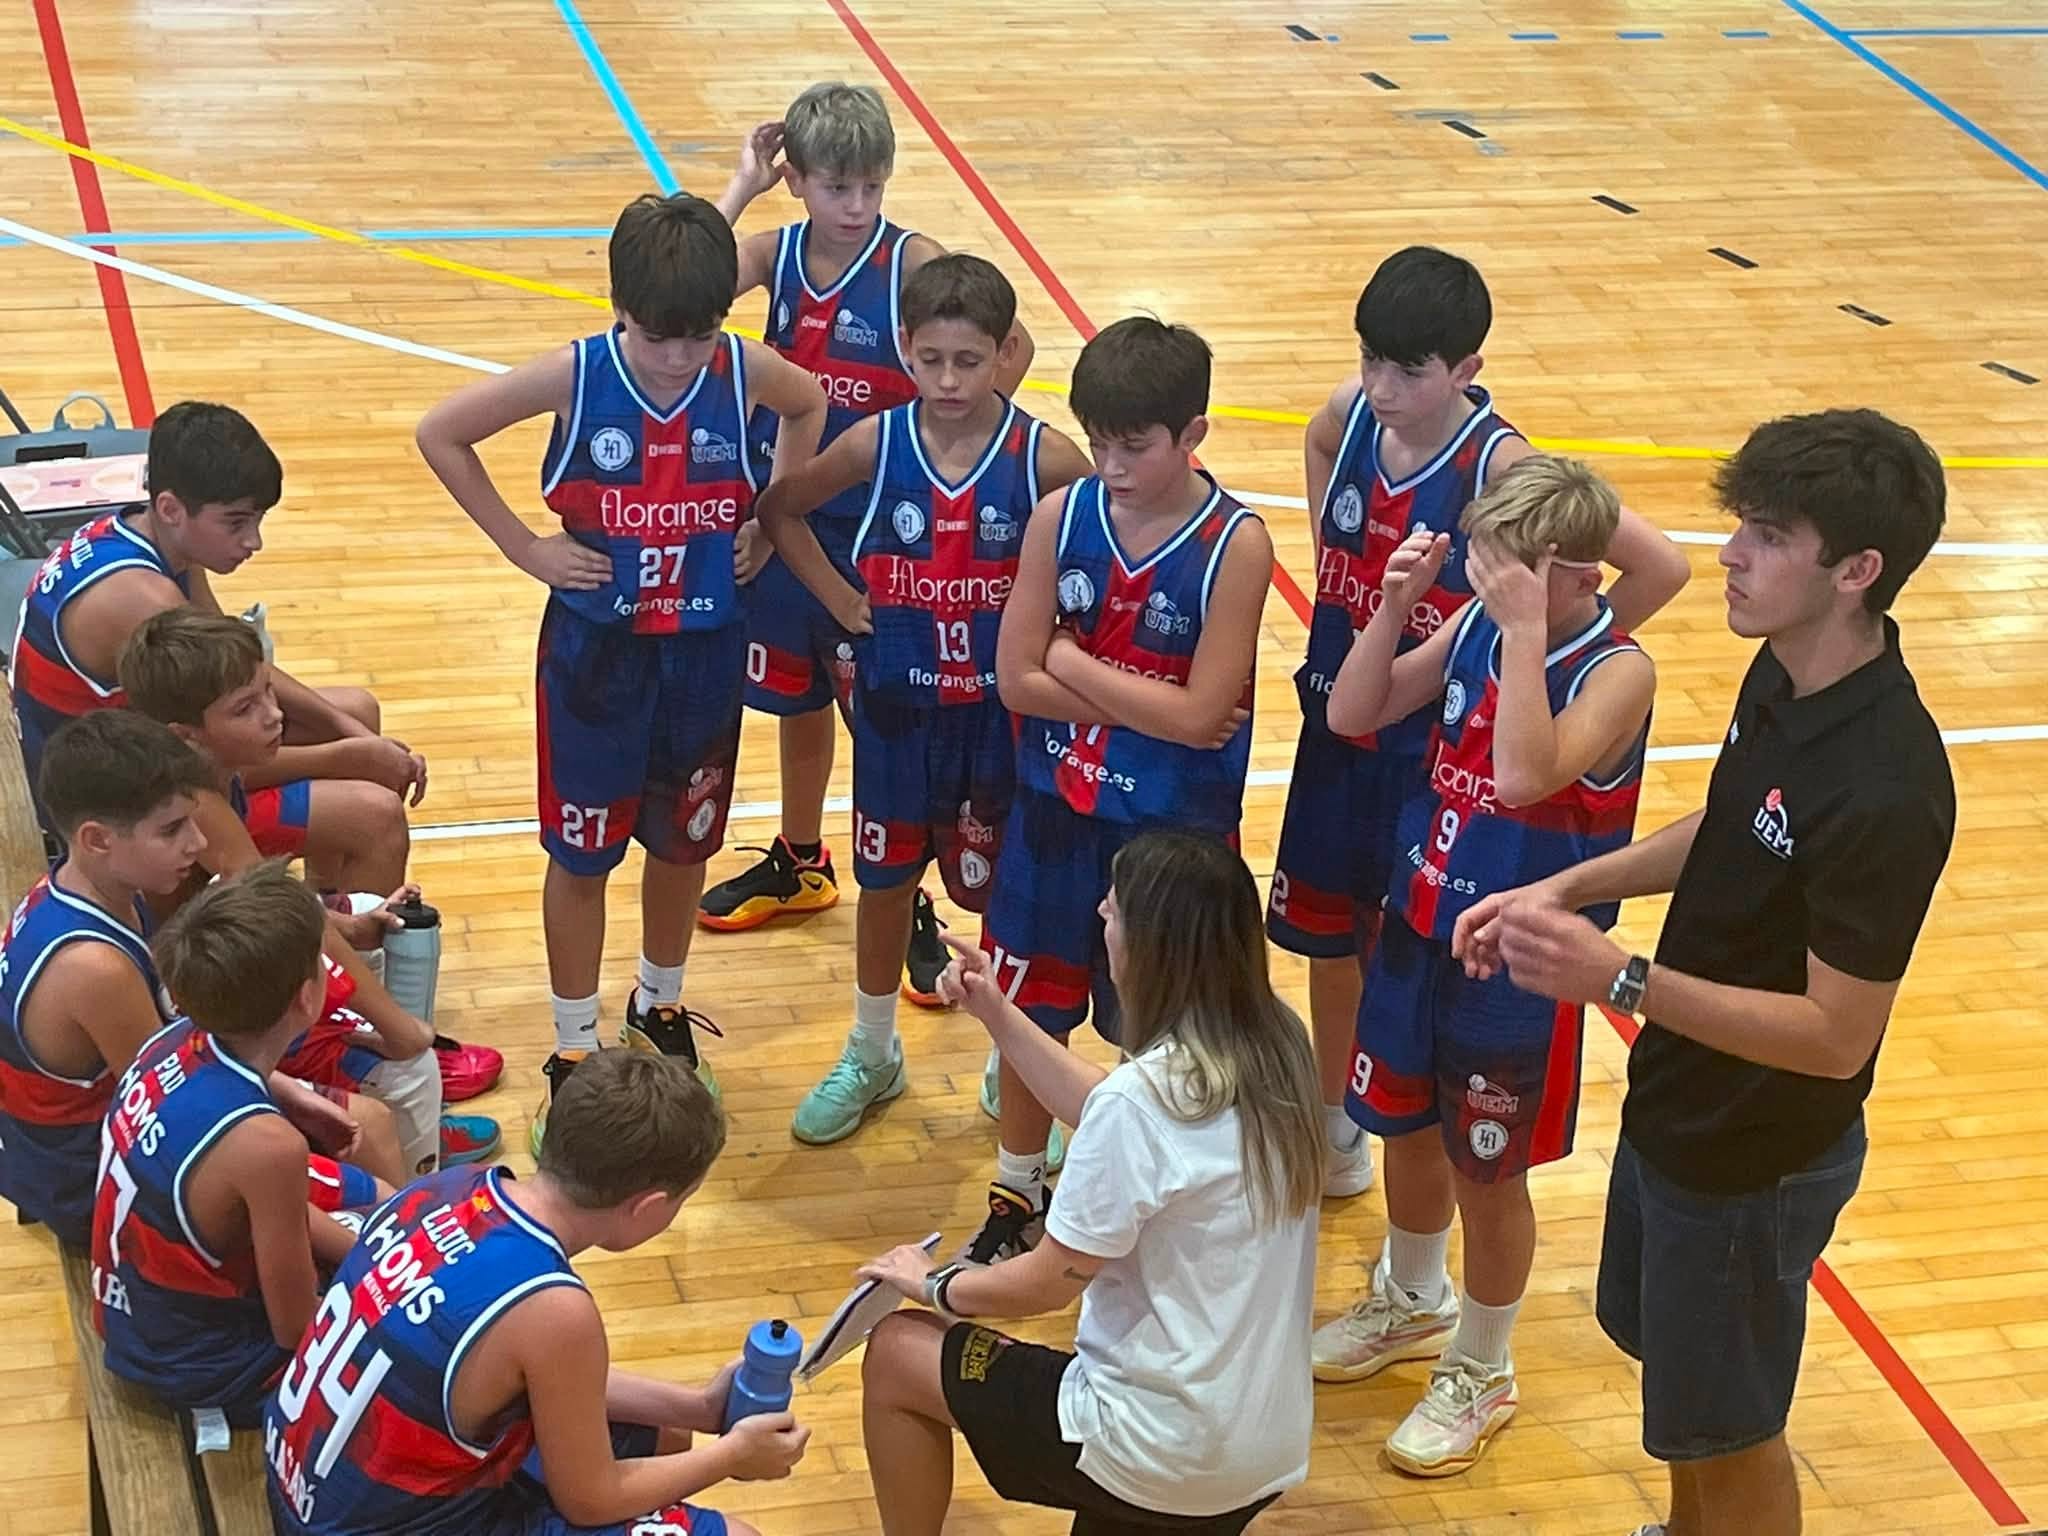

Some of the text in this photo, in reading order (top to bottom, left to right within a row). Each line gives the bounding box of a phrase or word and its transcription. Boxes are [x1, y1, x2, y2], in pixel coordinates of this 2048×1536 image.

[600, 489, 737, 530] florange
[639, 545, 688, 588] 27
[937, 621, 970, 662] 13
[561, 802, 608, 848] 27
[855, 811, 887, 863] 13
[1436, 808, 1460, 853] 9
[1754, 806, 1794, 857] UEM
[993, 944, 1030, 1002] 17
[1351, 1052, 1374, 1096] 9
[118, 1058, 166, 1157] HOMS
[1466, 1089, 1520, 1113] UEM
[421, 1203, 476, 1265] LLUC
[364, 1211, 446, 1325] HOMS
[277, 1281, 394, 1480] 34
